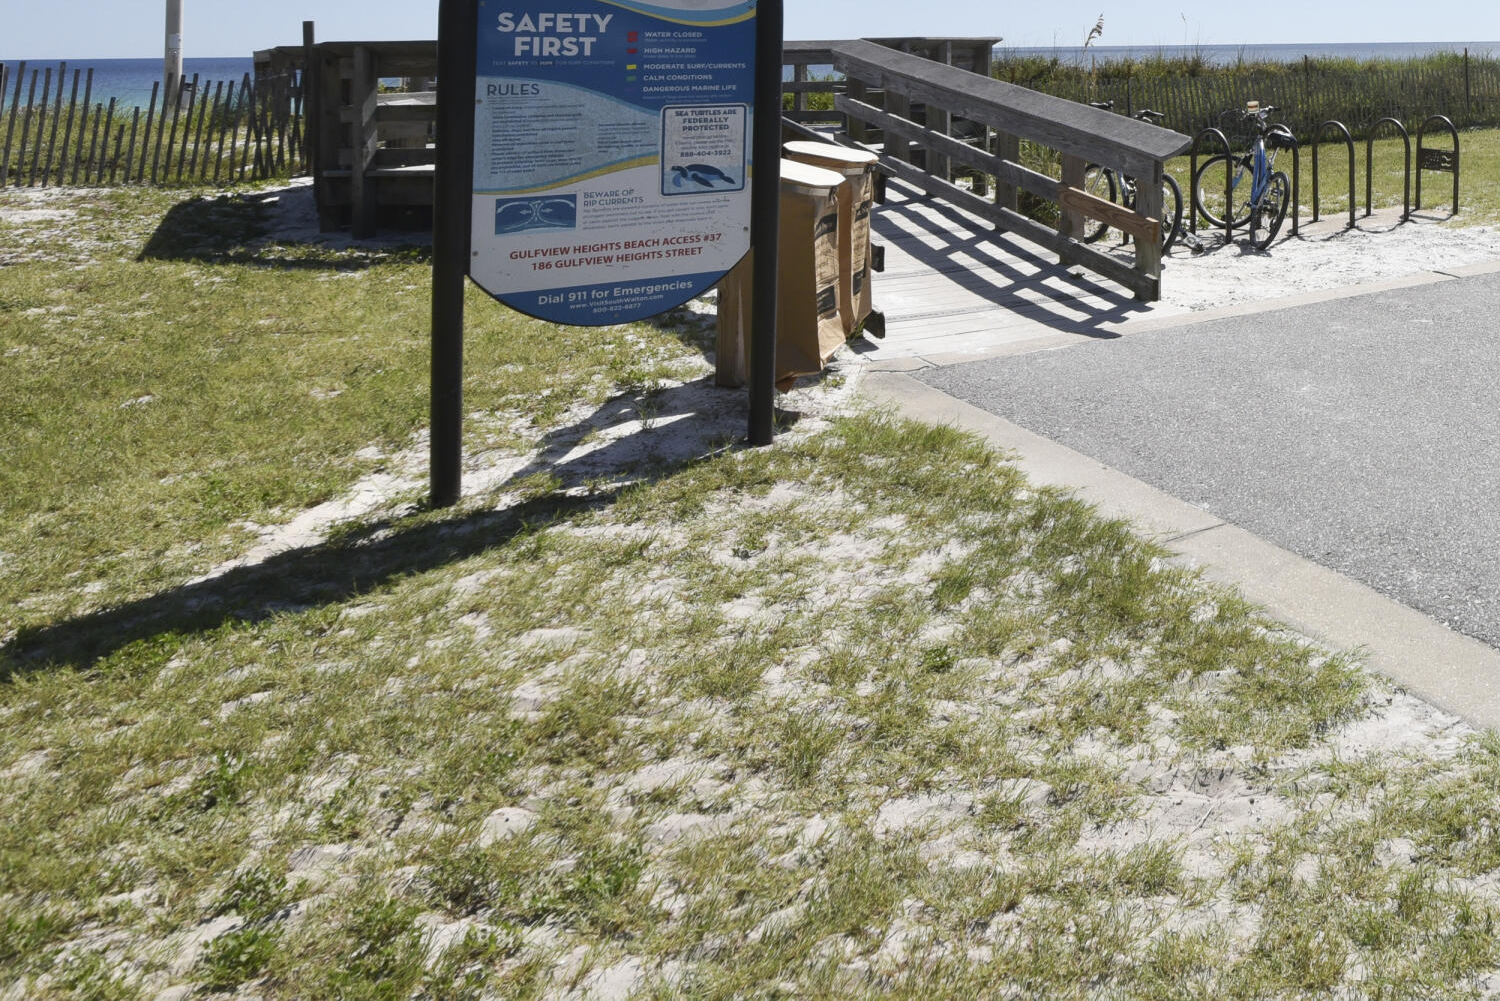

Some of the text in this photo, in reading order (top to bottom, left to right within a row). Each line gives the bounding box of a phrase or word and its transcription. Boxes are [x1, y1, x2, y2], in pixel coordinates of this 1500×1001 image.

[496, 12, 614, 33] SAFETY
[514, 36, 597, 57] FIRST
[487, 83, 540, 96] RULES
[682, 124, 730, 132] PROTECTED
[583, 191, 620, 199] BEWARE
[599, 197, 644, 206] CURRENTS
[509, 233, 722, 260] GULFVIEW HEIGHTS BEACH ACCESS #37
[531, 246, 703, 271] 186 GULFVIEW HEIGHTS STREET
[538, 280, 693, 305] Dial 911 for Emergencies
